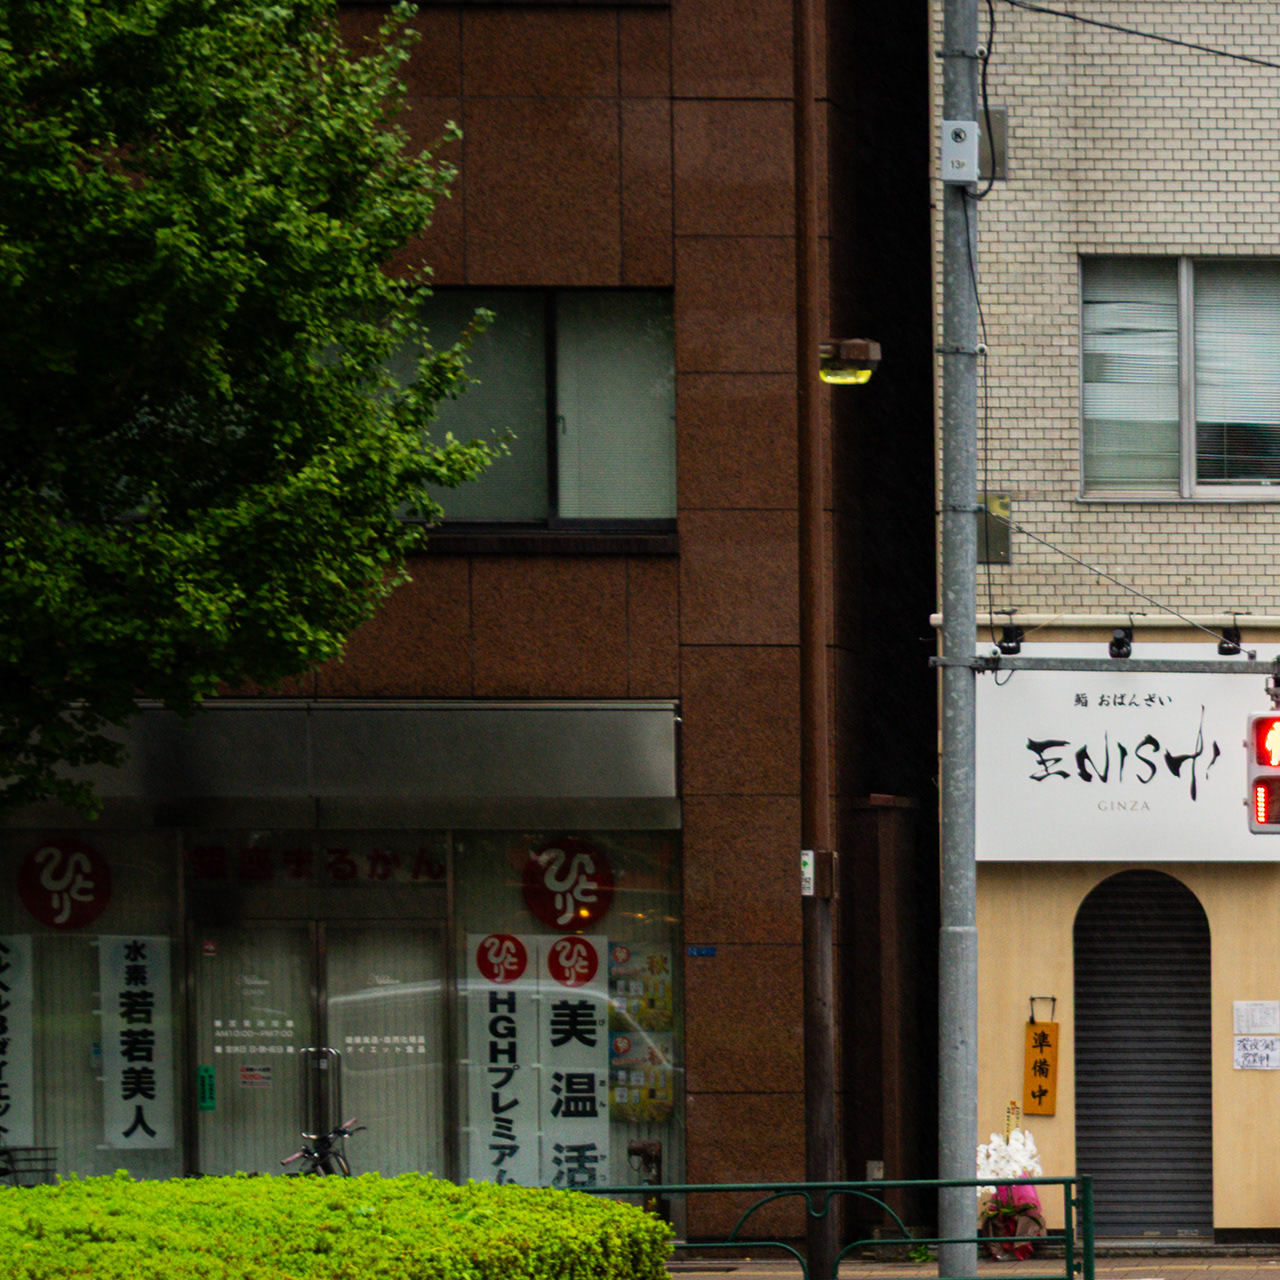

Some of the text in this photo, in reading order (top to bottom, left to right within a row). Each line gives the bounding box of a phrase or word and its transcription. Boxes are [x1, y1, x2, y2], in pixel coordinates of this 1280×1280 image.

[1074, 693, 1172, 707] 鮨 おばんざい
[1026, 704, 1220, 801] ENISHI
[1097, 800, 1151, 811] GINZA
[192, 846, 446, 881] 銀座まるかん
[550, 1000, 599, 1187] 美温活
[1031, 1030, 1051, 1106] 準備中
